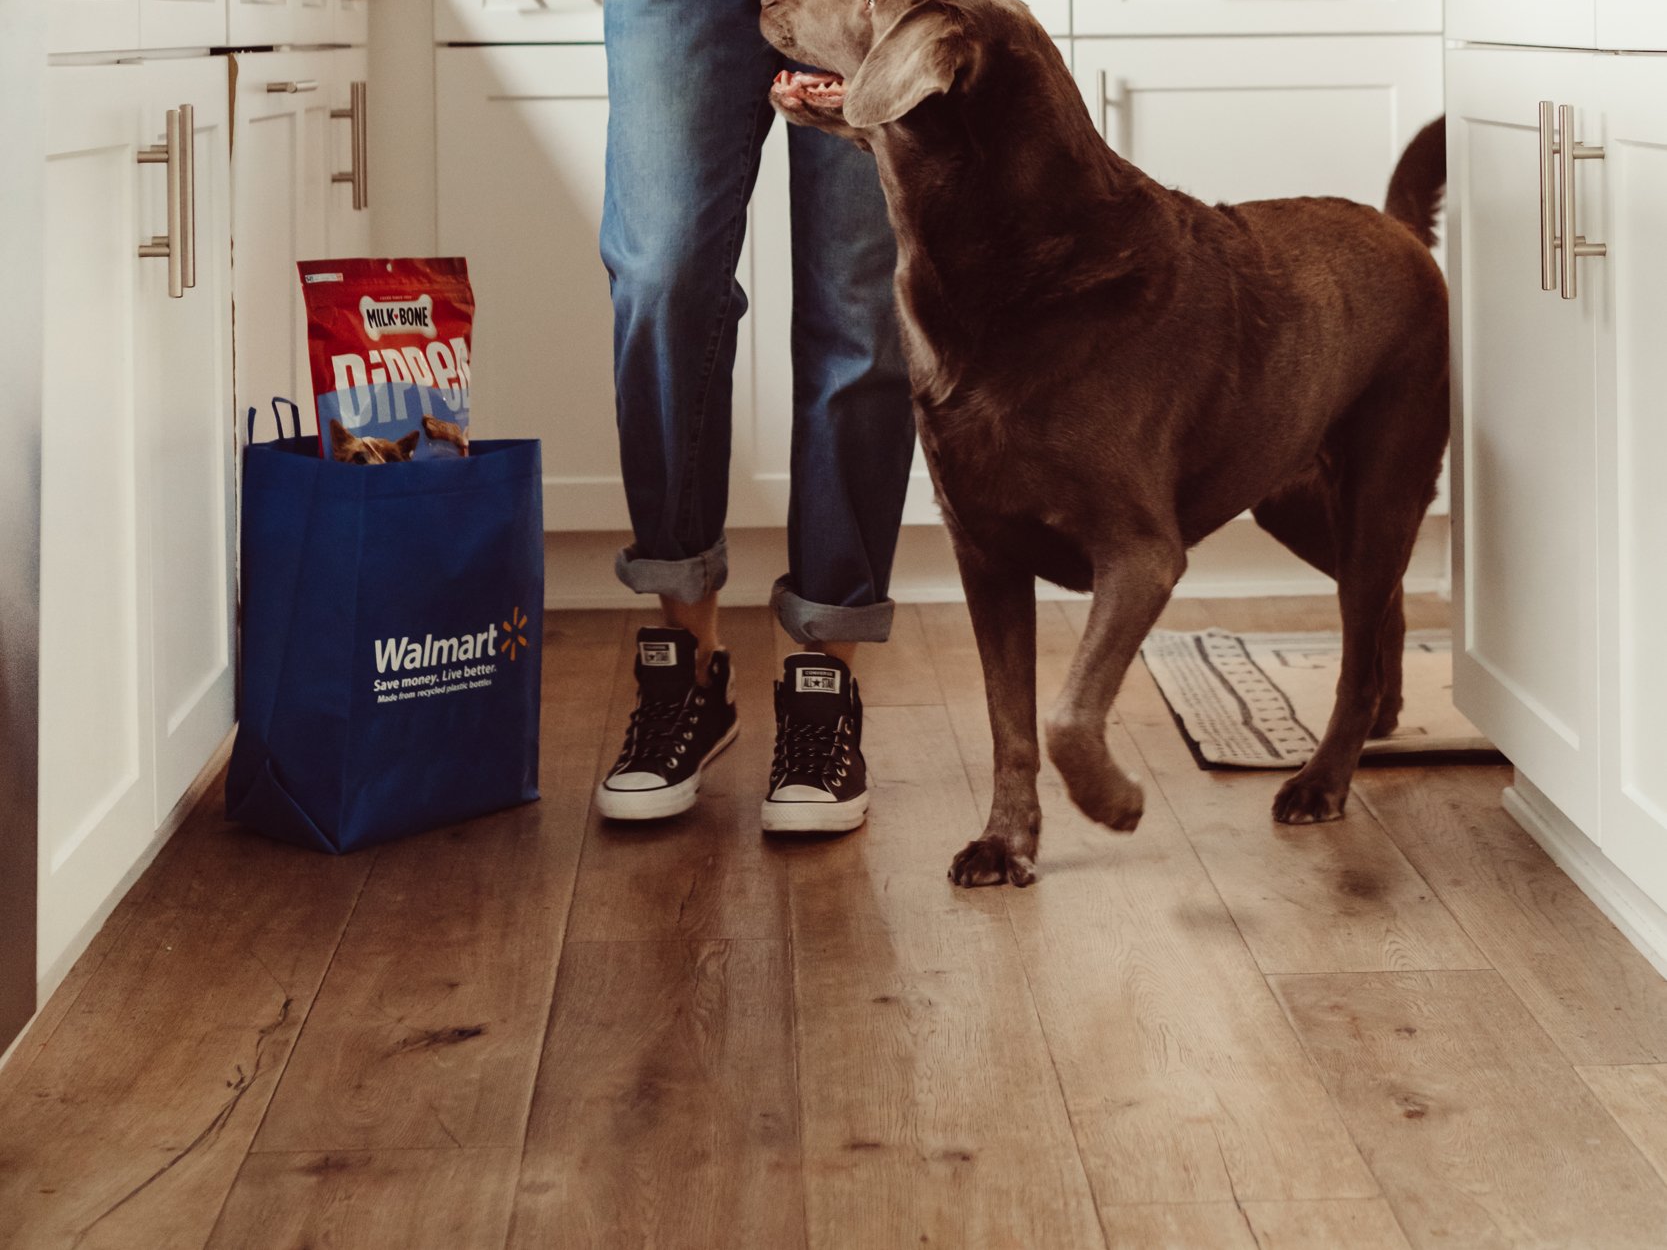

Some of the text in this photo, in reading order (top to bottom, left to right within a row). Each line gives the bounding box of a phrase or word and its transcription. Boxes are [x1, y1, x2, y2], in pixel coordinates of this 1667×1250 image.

[375, 624, 498, 673] Walmart
[373, 664, 497, 692] Save money. Live better.
[377, 678, 492, 703] Made from recycled plastic bottles
